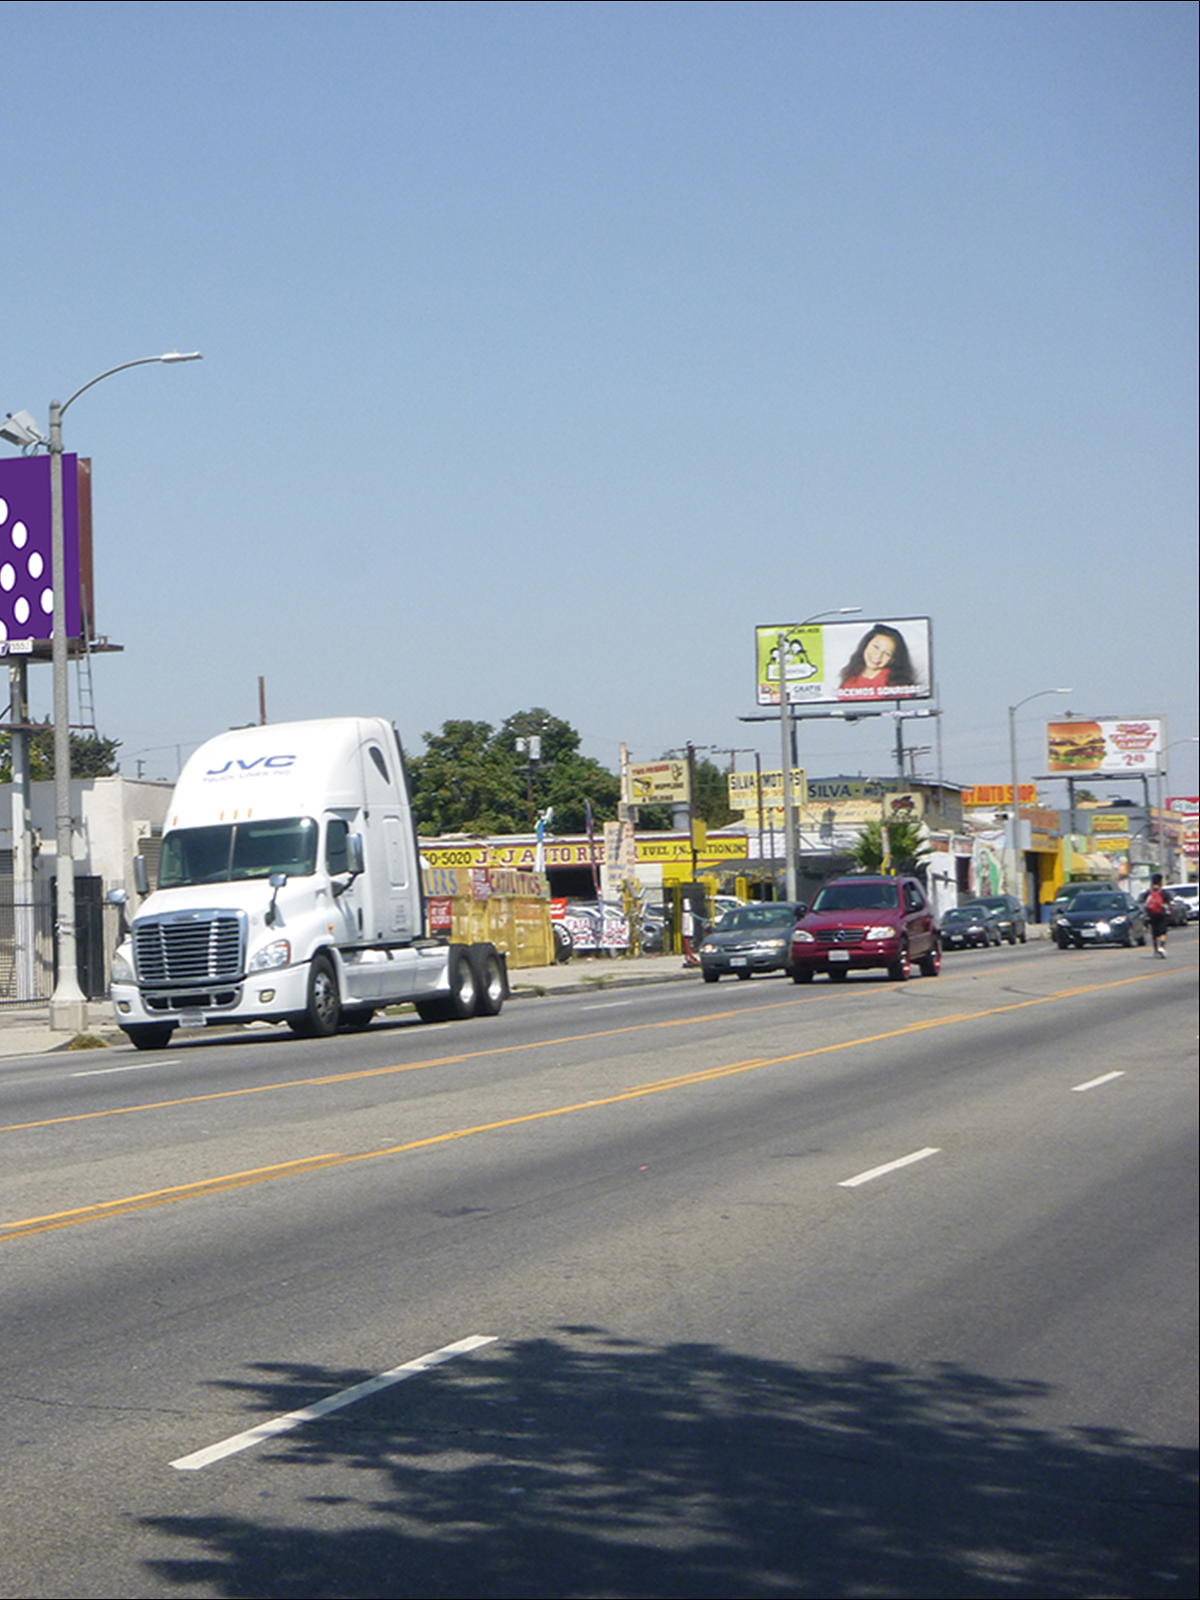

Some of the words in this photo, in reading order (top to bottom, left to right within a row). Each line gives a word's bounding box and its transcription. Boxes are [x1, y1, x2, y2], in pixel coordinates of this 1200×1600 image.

[833, 687, 875, 697] ACEMOS
[206, 755, 296, 775] JVC
[730, 775, 756, 790] SILVA
[762, 771, 801, 788] MOTRS
[808, 783, 851, 799] SILVA
[642, 846, 670, 856] FUEL
